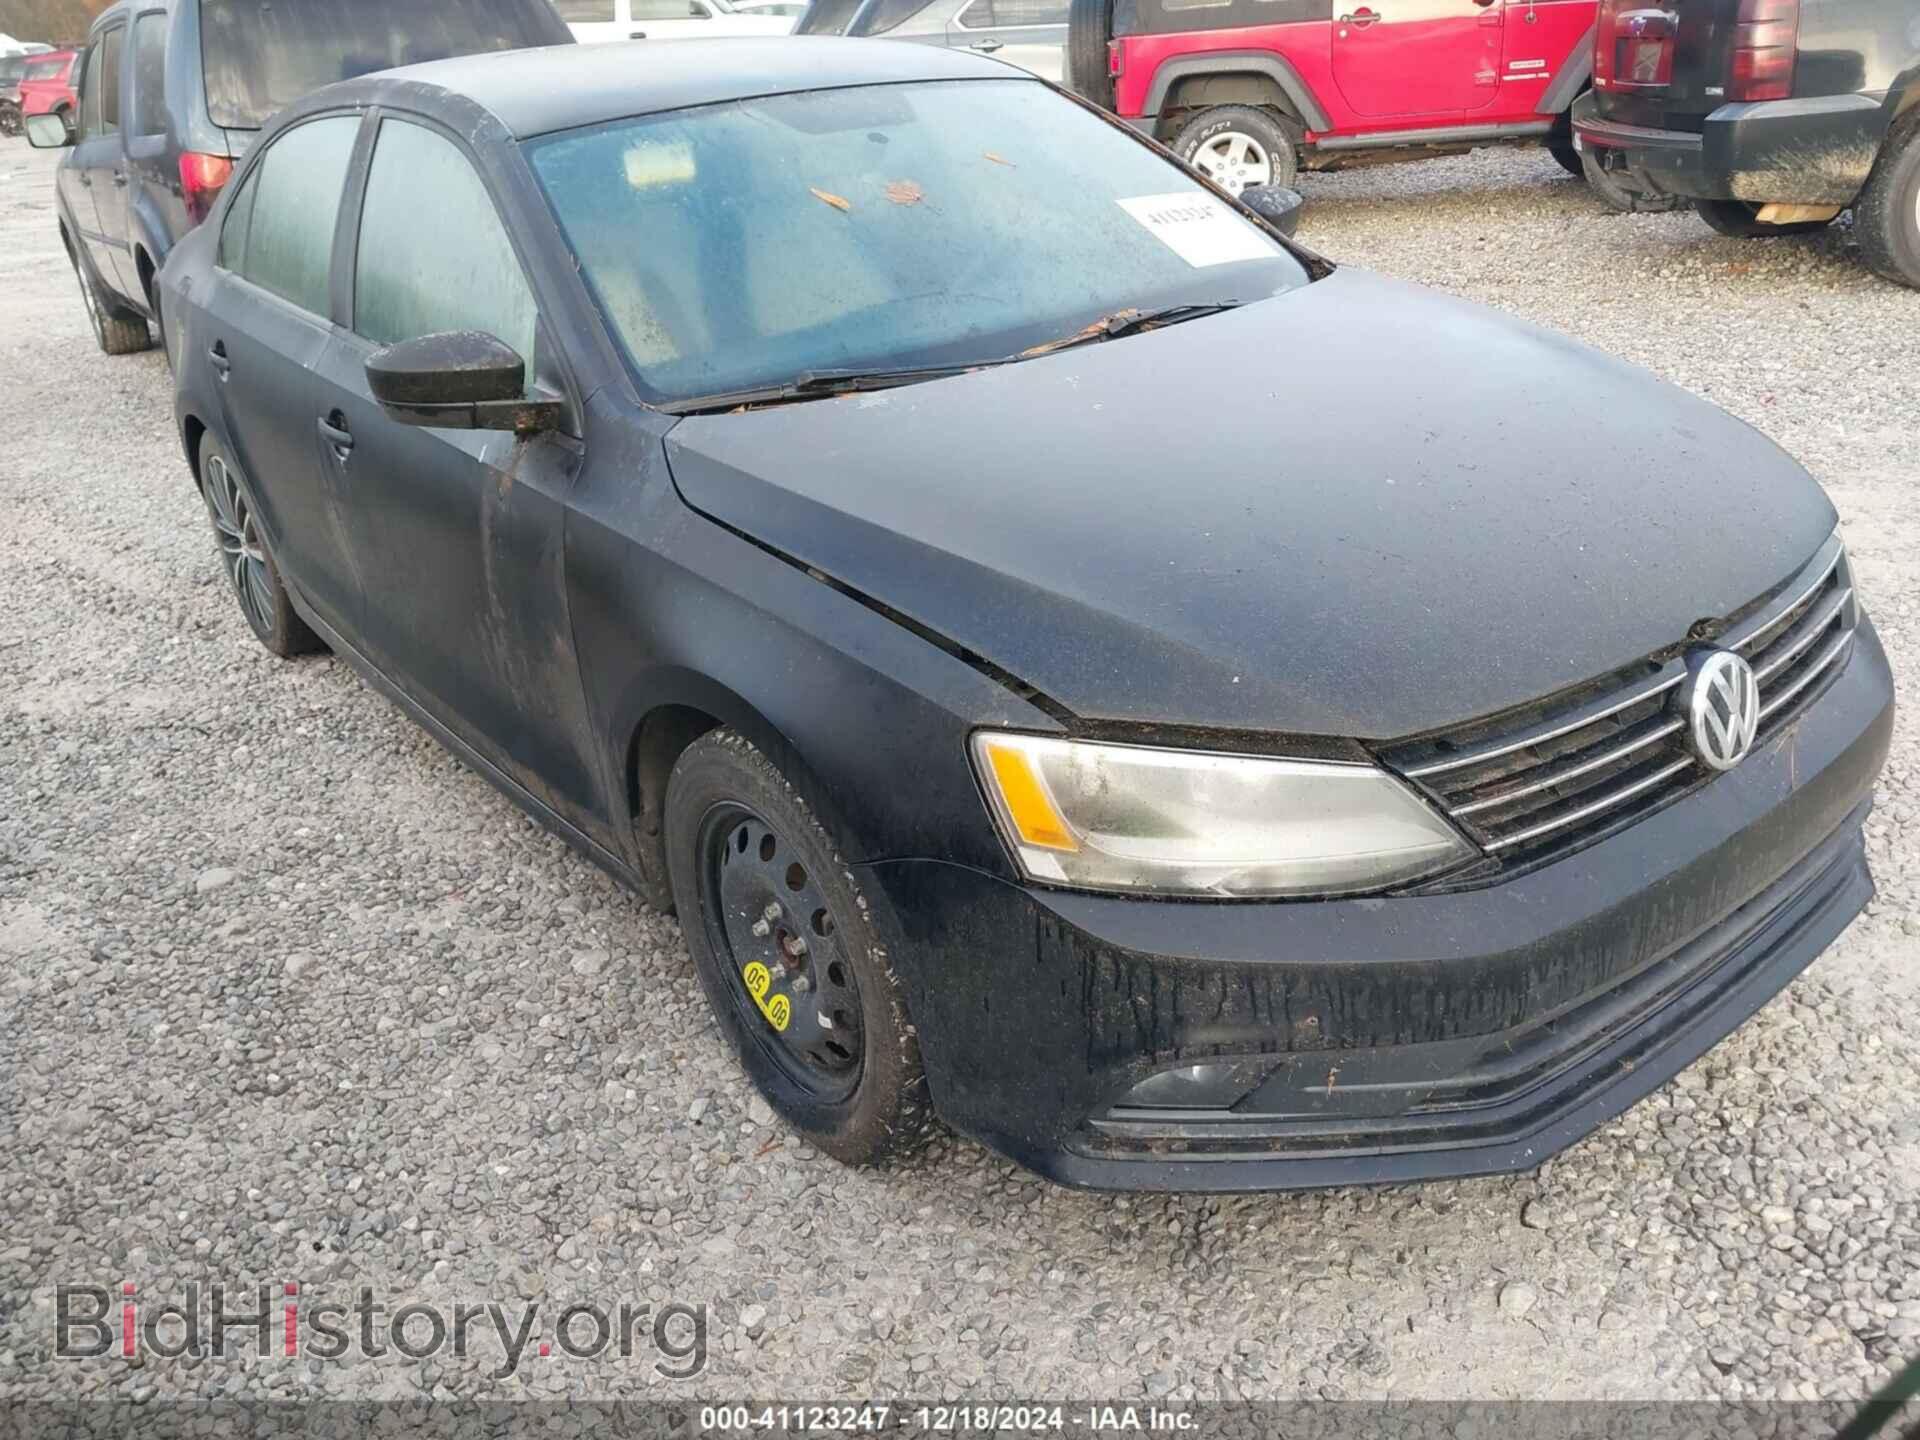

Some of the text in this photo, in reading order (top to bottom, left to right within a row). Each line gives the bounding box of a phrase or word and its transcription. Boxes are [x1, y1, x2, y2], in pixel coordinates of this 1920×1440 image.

[1691, 651, 1760, 771] VW
[747, 967, 788, 1027] 80 50
